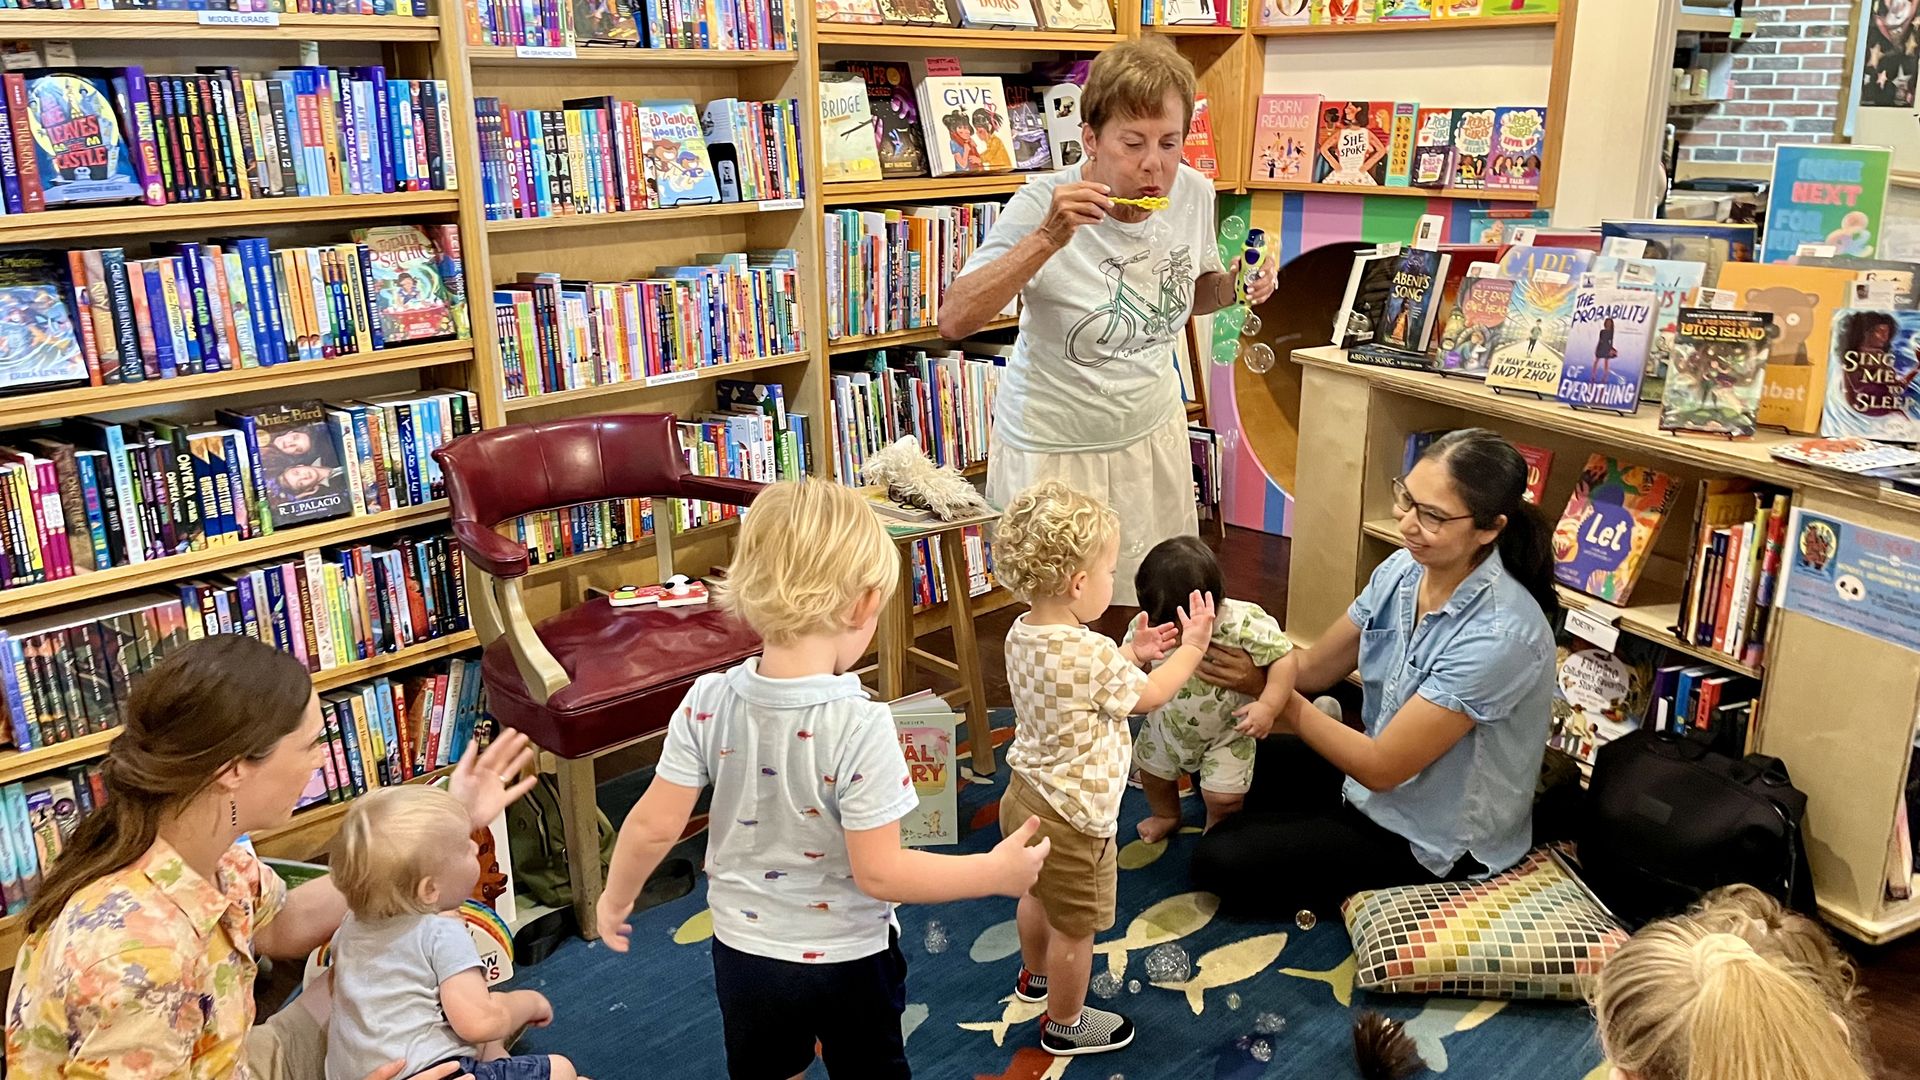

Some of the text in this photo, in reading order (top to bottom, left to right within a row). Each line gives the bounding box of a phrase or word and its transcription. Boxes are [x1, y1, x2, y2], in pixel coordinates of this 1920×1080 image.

[208, 15, 270, 25] MIDDLE GRADE
[341, 77, 354, 126] SKATING
[822, 95, 861, 117] BRIDGE
[943, 86, 992, 106] GIVE
[1269, 99, 1303, 114] BORN
[49, 115, 100, 143] LEAVES
[1260, 114, 1310, 128] READING
[134, 102, 157, 172] MONSTER CAMP
[275, 109, 292, 168] LIFEBOAT 12
[347, 127, 357, 145] ON
[1342, 132, 1365, 147] SHE
[55, 148, 107, 169] CASTLE
[1340, 144, 1367, 158] SPOKE
[504, 136, 520, 200] HOOPS
[524, 149, 534, 185] DRAMA
[1791, 181, 1863, 207] NEXT
[1775, 208, 1823, 234] FOR
[368, 243, 434, 269] PSYCHIC
[110, 262, 129, 312] CREATURES
[192, 268, 201, 284] LOPEZ
[1392, 271, 1432, 289] ABENI'S
[1391, 284, 1424, 302] SONG
[1472, 289, 1489, 298] ELF
[1576, 292, 1596, 309] THE
[1571, 304, 1650, 328] PROBABILITY
[1681, 322, 1766, 341] LOTUS ISLAND
[1350, 353, 1375, 363] ABENI'S
[1375, 356, 1395, 366] SONG
[1504, 356, 1551, 370] MANY MASKS
[1843, 350, 1896, 373] SING
[1490, 364, 1557, 383] ANDY ZHOU
[1566, 365, 1585, 379] OF
[1862, 366, 1896, 384] ME
[1558, 378, 1635, 406] EVERYTHING
[1854, 392, 1919, 413] SLEEP
[253, 406, 322, 426] White Bird
[401, 418, 420, 492] TUMBLE
[780, 432, 790, 465] Vehicles
[754, 453, 762, 480] Ocean
[766, 445, 774, 482] Rainfores
[176, 453, 196, 498] ONYEKA
[165, 471, 180, 503] ONYEKA
[199, 475, 218, 519] GHOSTLIGHT
[215, 472, 234, 516] GHOSTLIGHT
[279, 496, 341, 516] R. J. PALACIO
[1585, 513, 1628, 552] Let
[451, 549, 466, 617] THEO TAN FOX SPIRIT
[1571, 616, 1595, 632] POETRY
